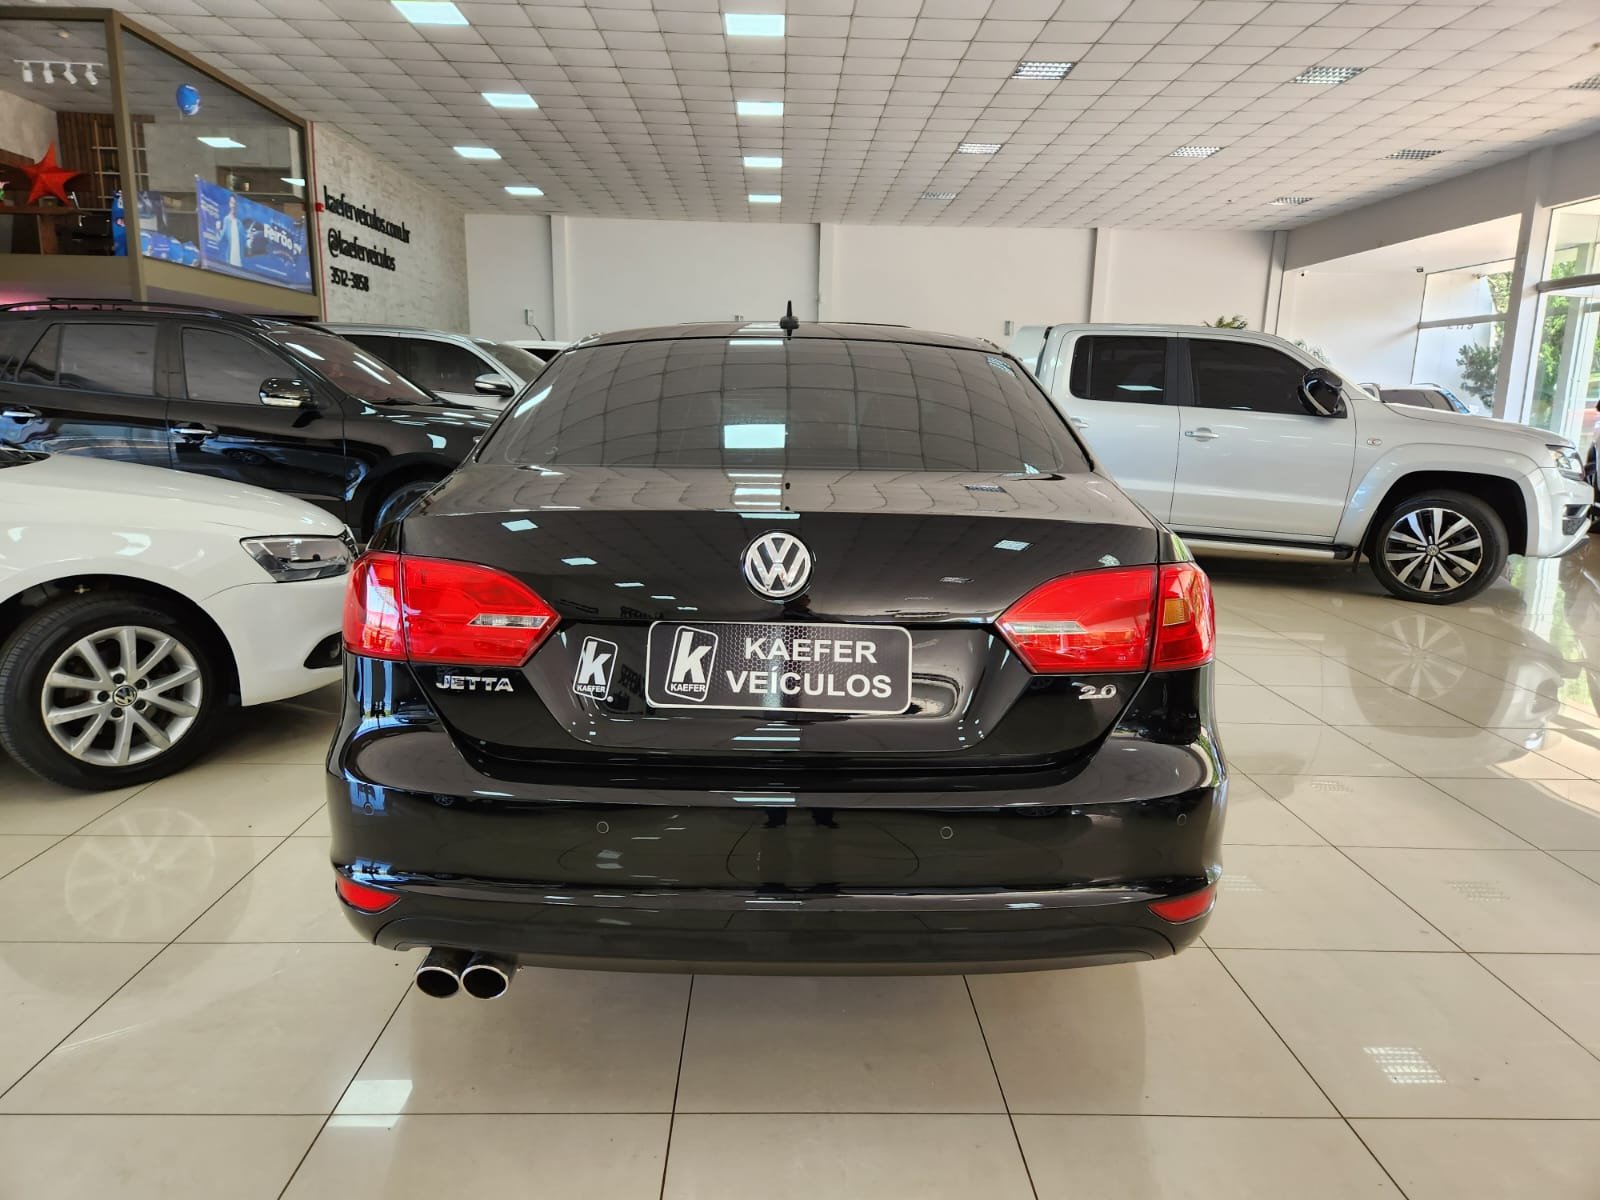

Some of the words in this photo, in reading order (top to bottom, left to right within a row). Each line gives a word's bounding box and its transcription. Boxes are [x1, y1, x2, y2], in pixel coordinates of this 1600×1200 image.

[745, 637, 878, 664] KAEFER
[435, 675, 514, 692] JETTA
[576, 684, 606, 693] KAEFER
[670, 683, 706, 693] KAEFER
[726, 665, 892, 698] VEÍCULOS
[1078, 684, 1117, 700] 2.0
